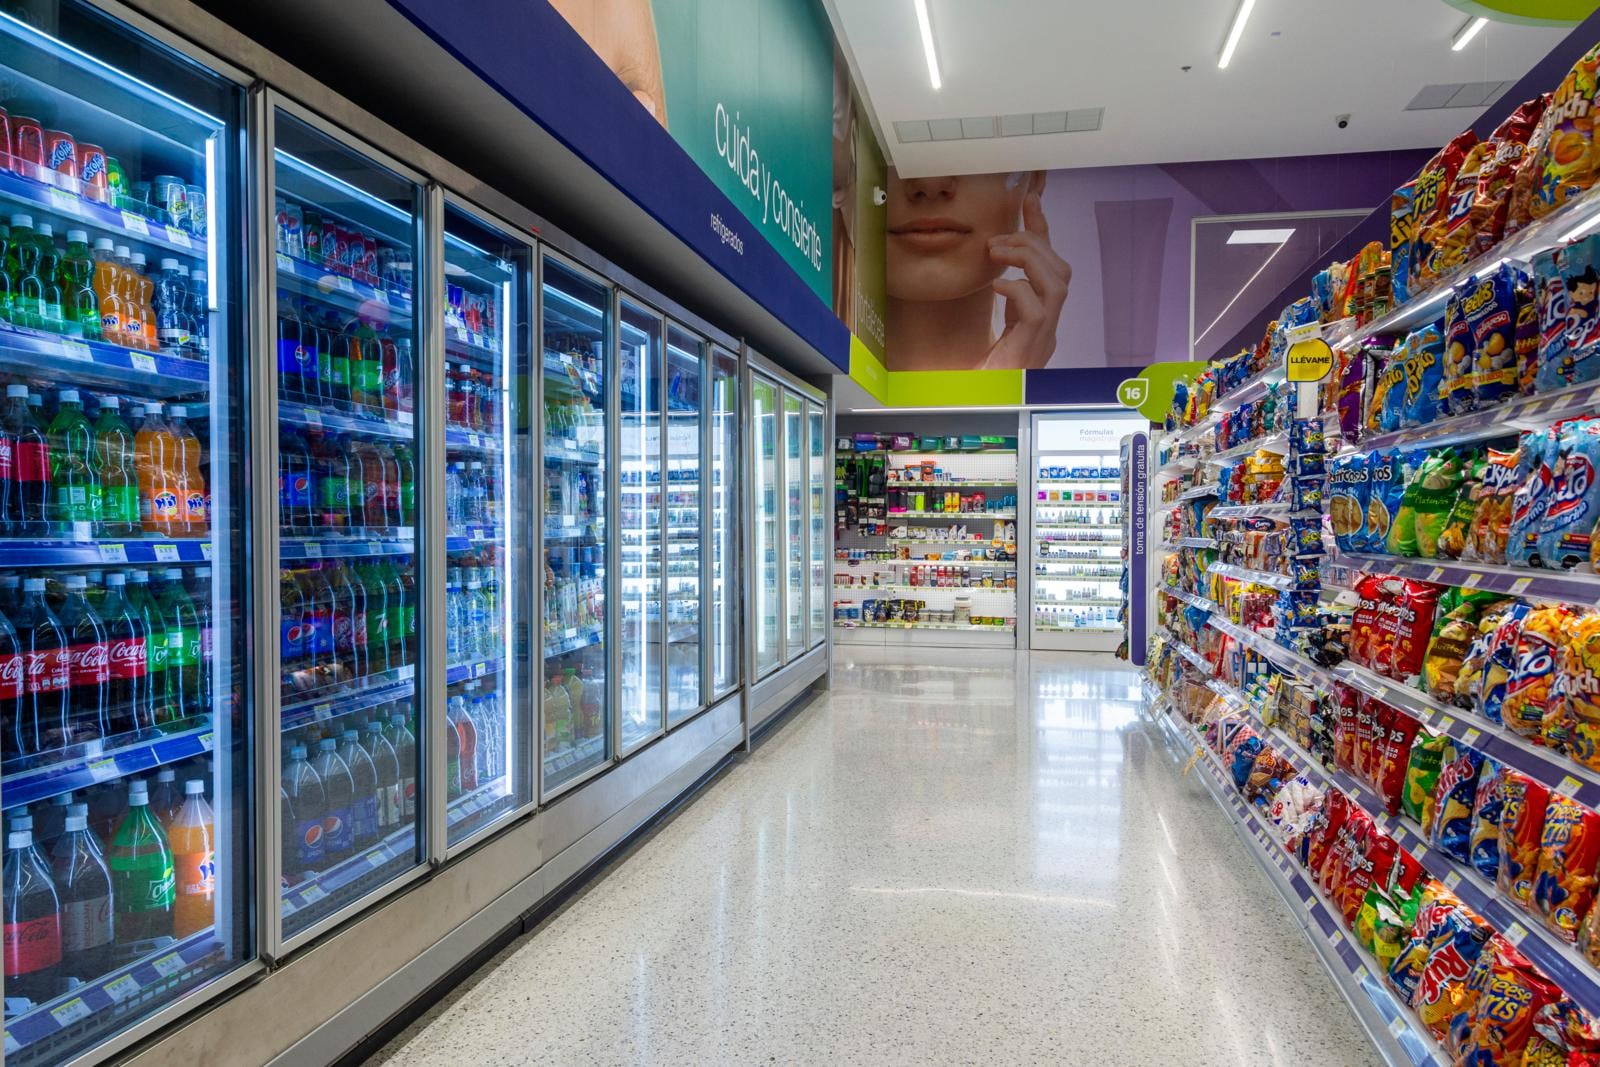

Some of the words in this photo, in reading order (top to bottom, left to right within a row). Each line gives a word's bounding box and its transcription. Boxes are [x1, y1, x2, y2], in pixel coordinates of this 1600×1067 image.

[713, 103, 760, 201] cuida
[762, 163, 771, 225] y
[772, 180, 822, 272] consiente
[711, 213, 744, 256] refrigerados
[1291, 355, 1330, 364] LLÉVAME
[1125, 387, 1141, 400] 16
[1080, 428, 1114, 436] Fórmulas
[1135, 444, 1147, 479] gratuita
[1135, 481, 1144, 515] tensión
[1135, 517, 1144, 530] de
[1135, 532, 1144, 555] toma
